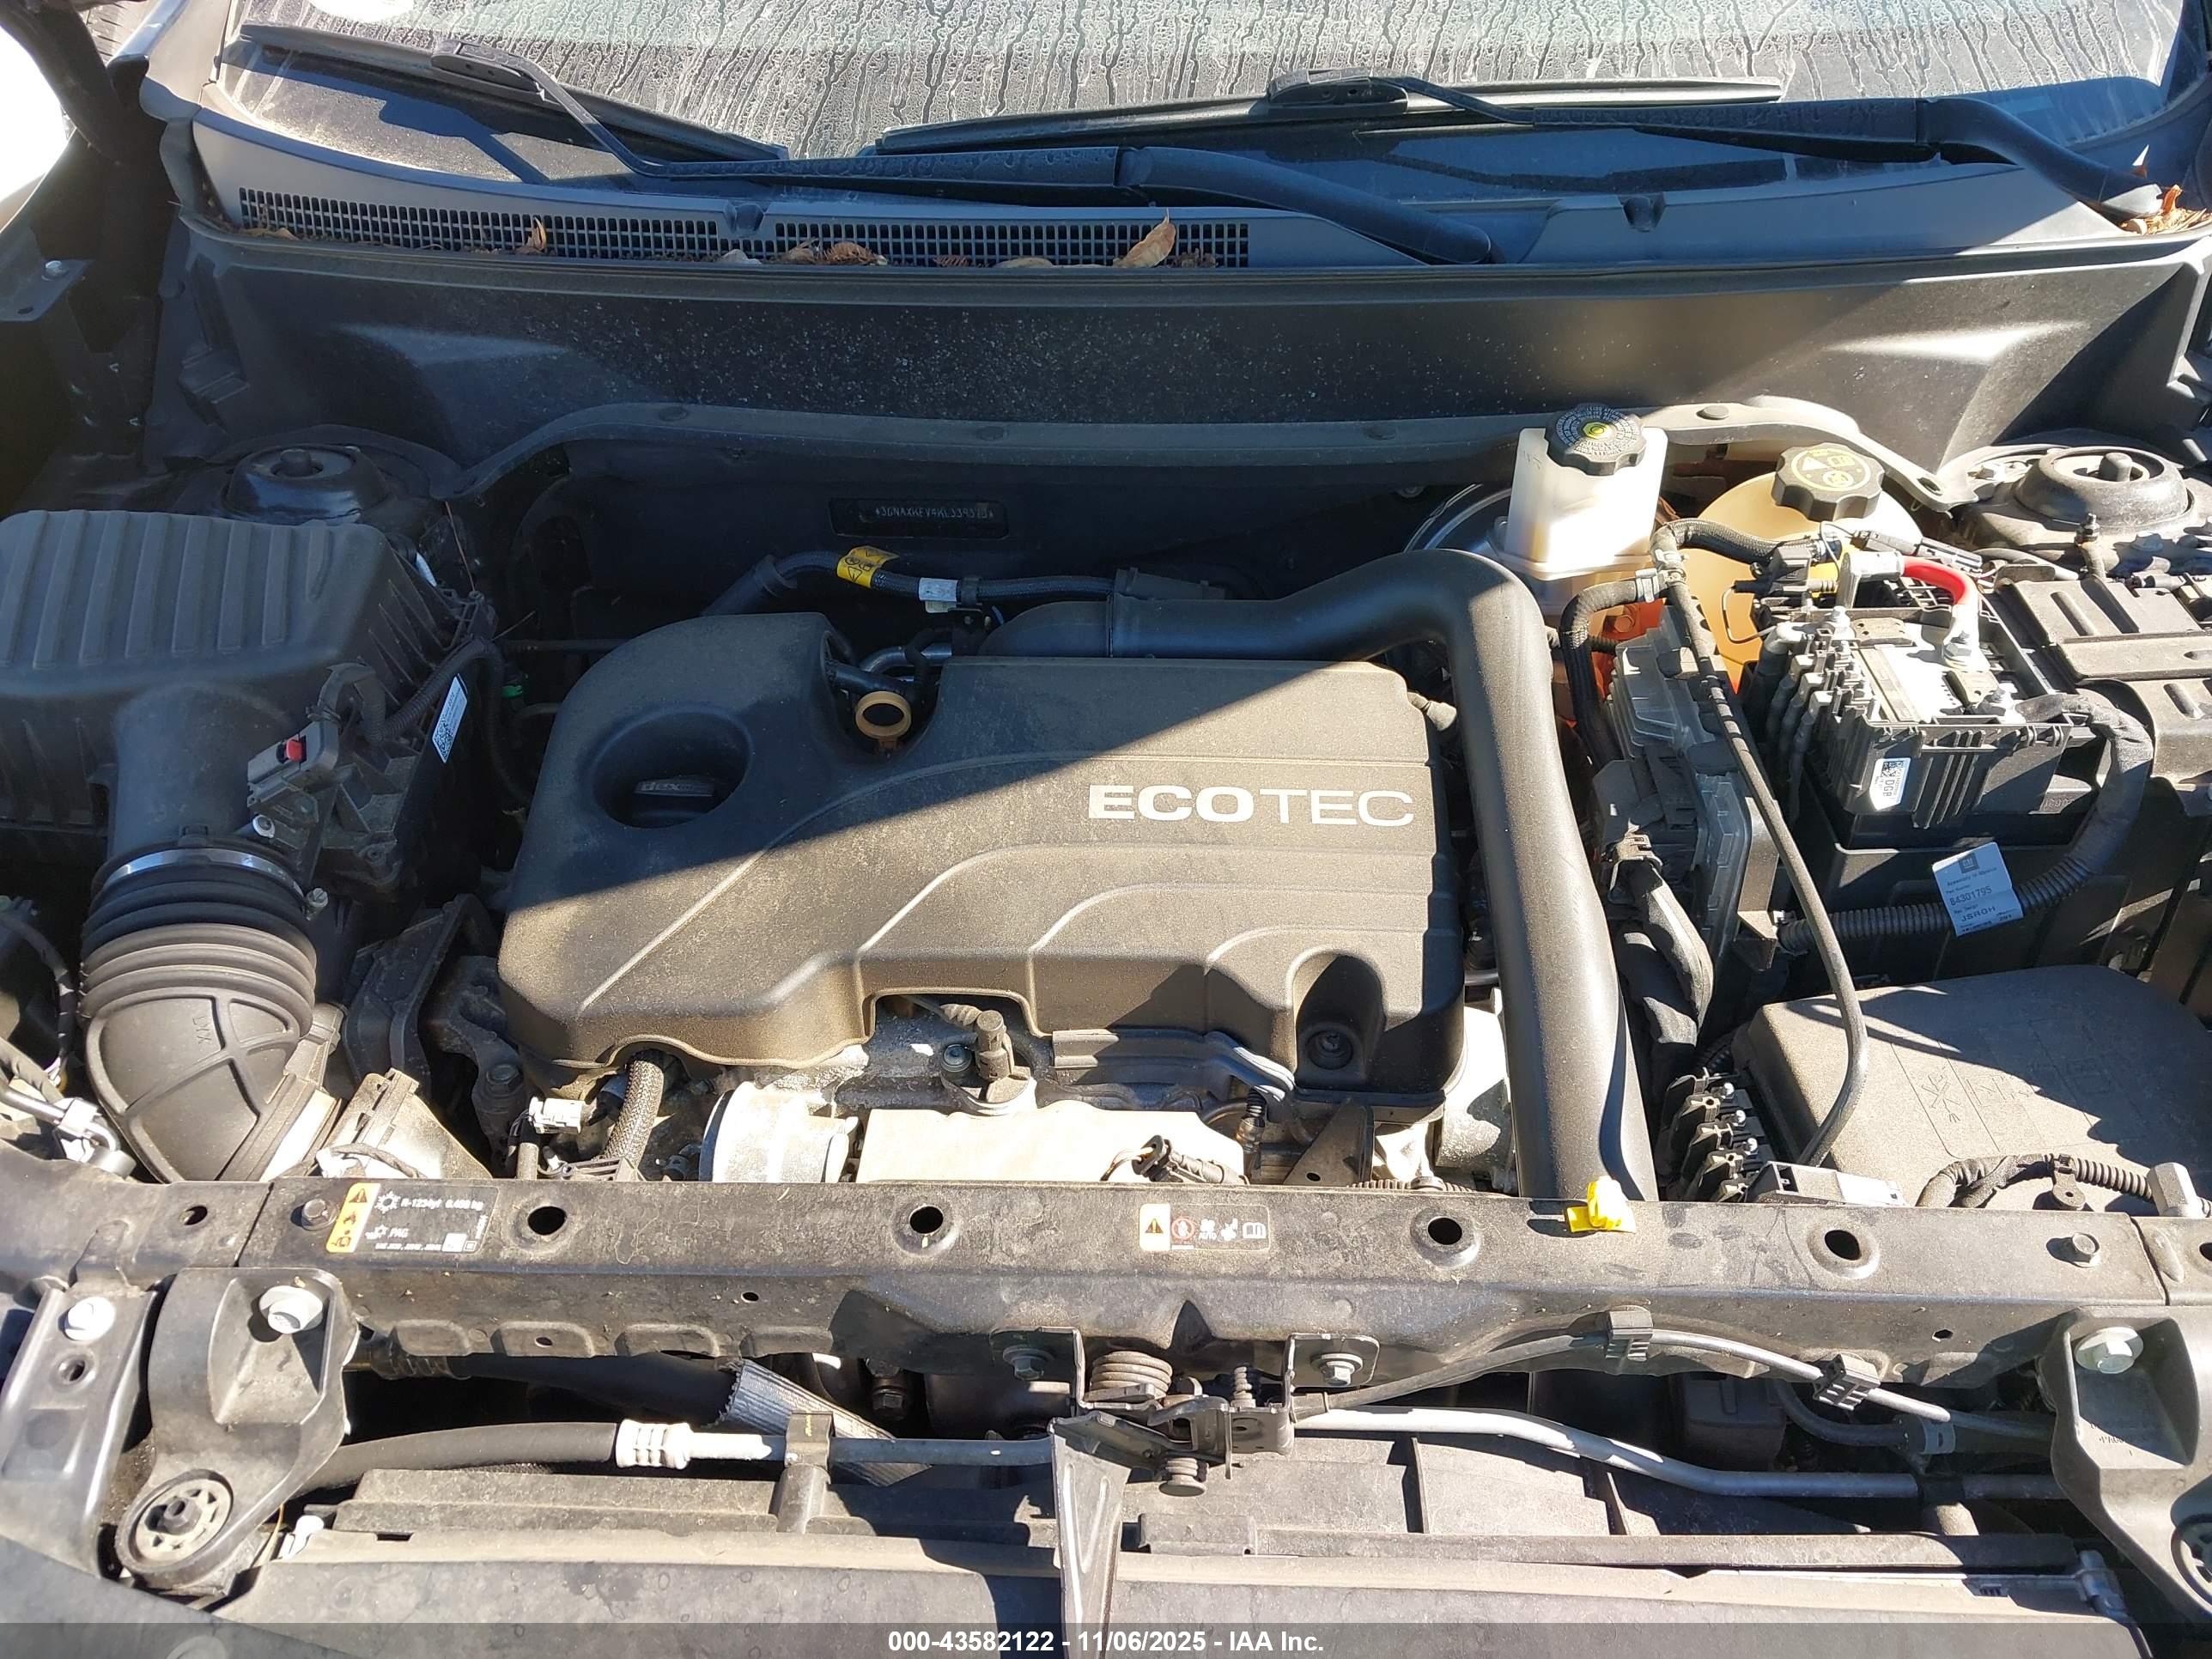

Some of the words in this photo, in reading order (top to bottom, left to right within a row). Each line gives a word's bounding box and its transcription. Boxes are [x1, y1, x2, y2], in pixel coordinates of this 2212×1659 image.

[1088, 784, 1414, 827] ECOTEC
[1949, 885, 1992, 906] 84301795
[387, 1227, 410, 1238] PAG
